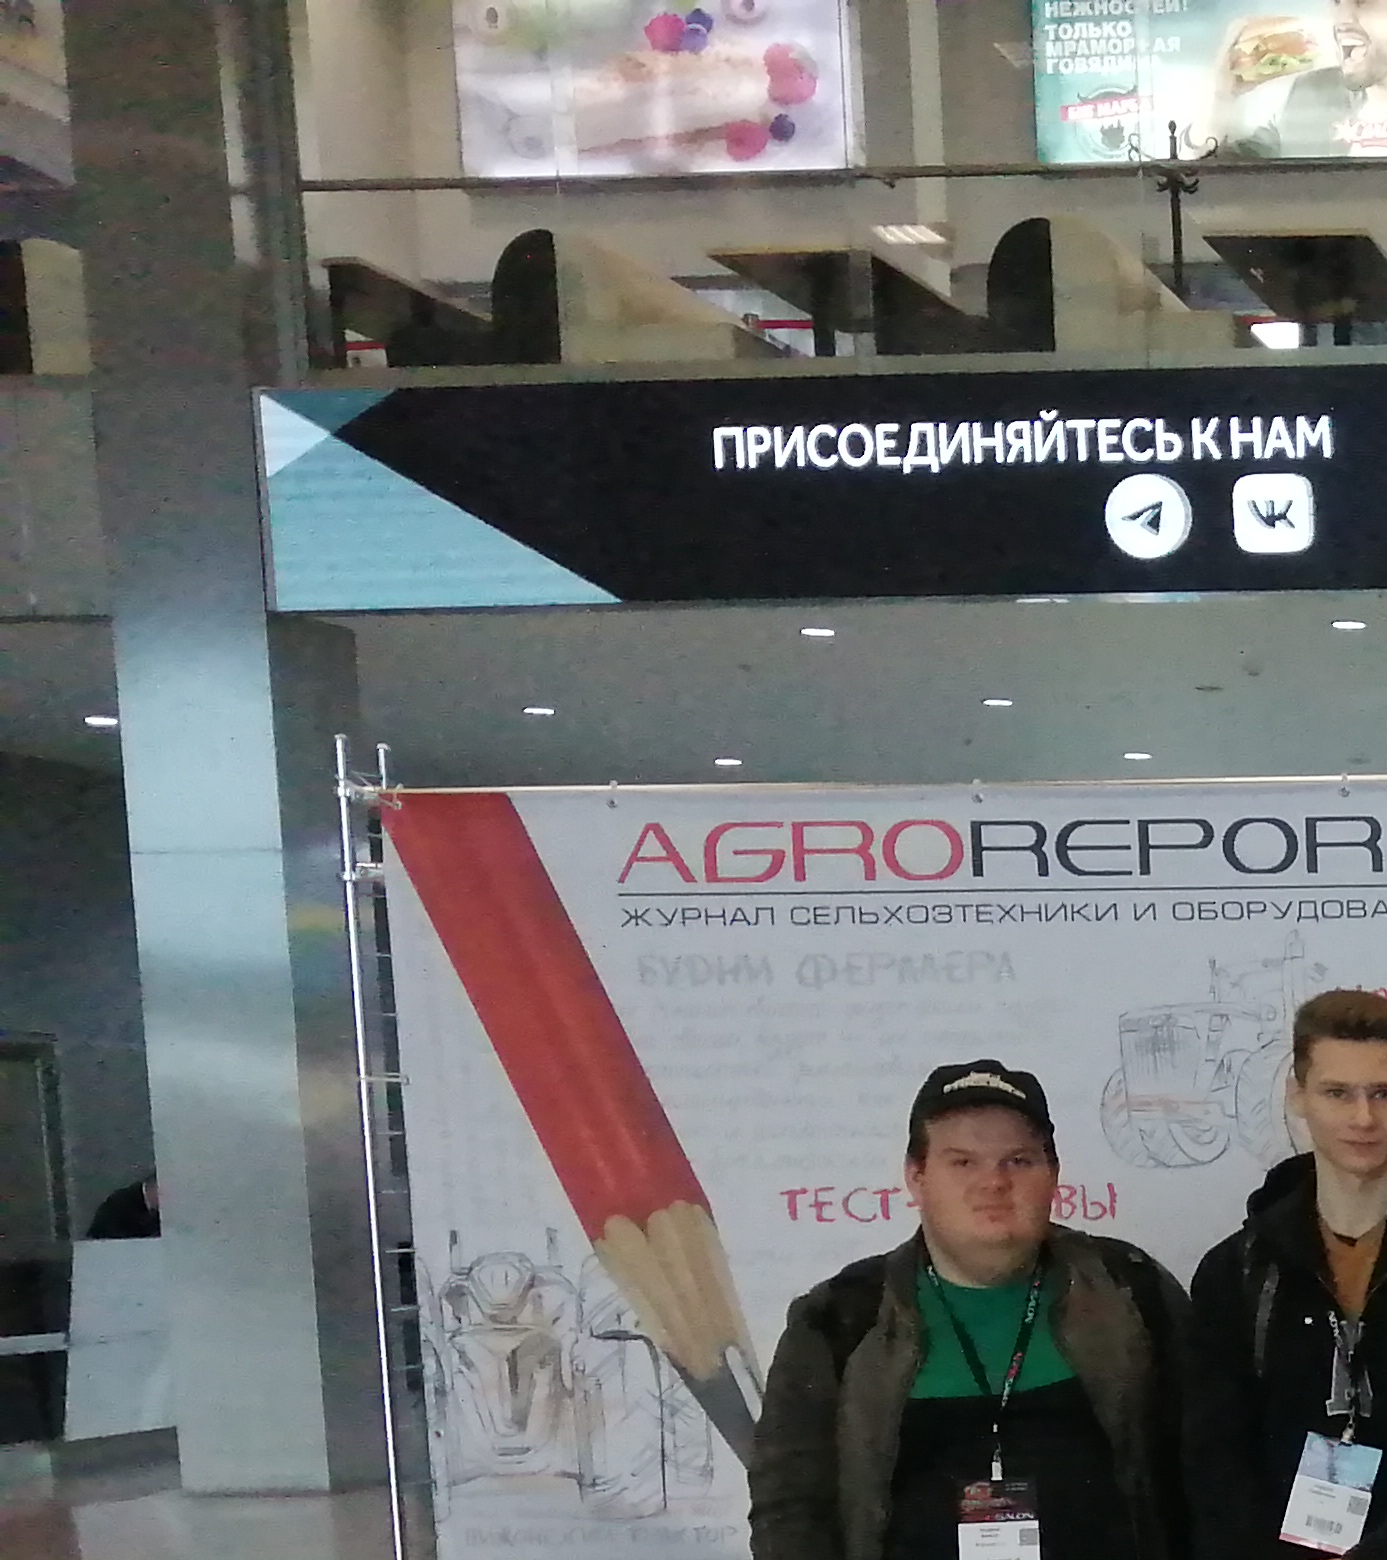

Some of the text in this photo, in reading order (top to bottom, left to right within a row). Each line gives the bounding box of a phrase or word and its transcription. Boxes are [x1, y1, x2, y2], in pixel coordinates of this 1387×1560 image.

[1045, 20, 1133, 39] ТОЛЬКО
[1045, 37, 1181, 57] МРАМОРАЯ
[712, 410, 1333, 474] ПРИСОЕДИНЯЙТЕСЬ К НАМ
[620, 904, 777, 929] ЖУРНАЛ
[789, 900, 1119, 926] СЕЛЬХОЗТЕХНИКИ
[1133, 900, 1157, 922] И
[795, 950, 1018, 990] ФЕРМЕРА
